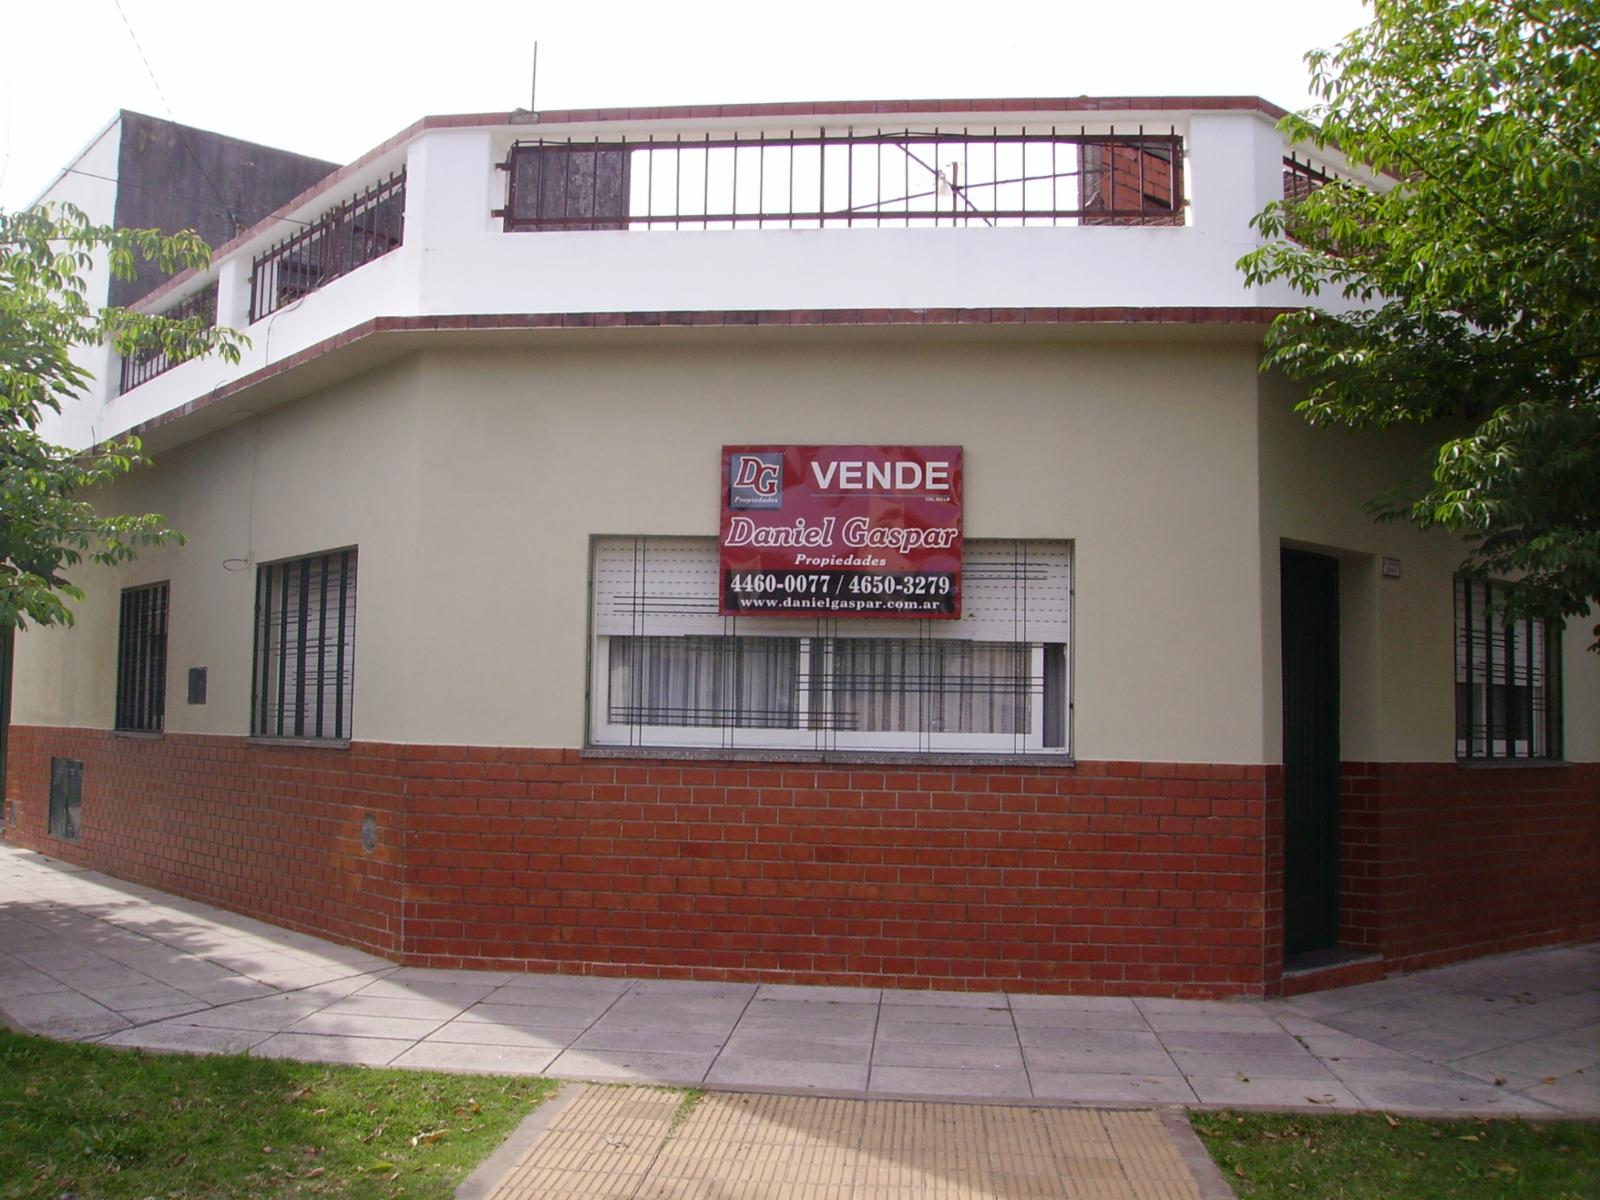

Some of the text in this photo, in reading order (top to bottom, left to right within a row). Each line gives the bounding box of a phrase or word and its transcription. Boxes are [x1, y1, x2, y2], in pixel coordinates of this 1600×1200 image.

[811, 462, 949, 489] VENDE
[734, 496, 778, 504] Propiedades
[725, 516, 957, 553] Daniel Gaspar
[795, 554, 886, 567] Propiedades
[731, 574, 830, 593] 4460-0077
[849, 576, 950, 595] 4650-3279
[740, 597, 940, 611] www.danielgaspar.com.ar
